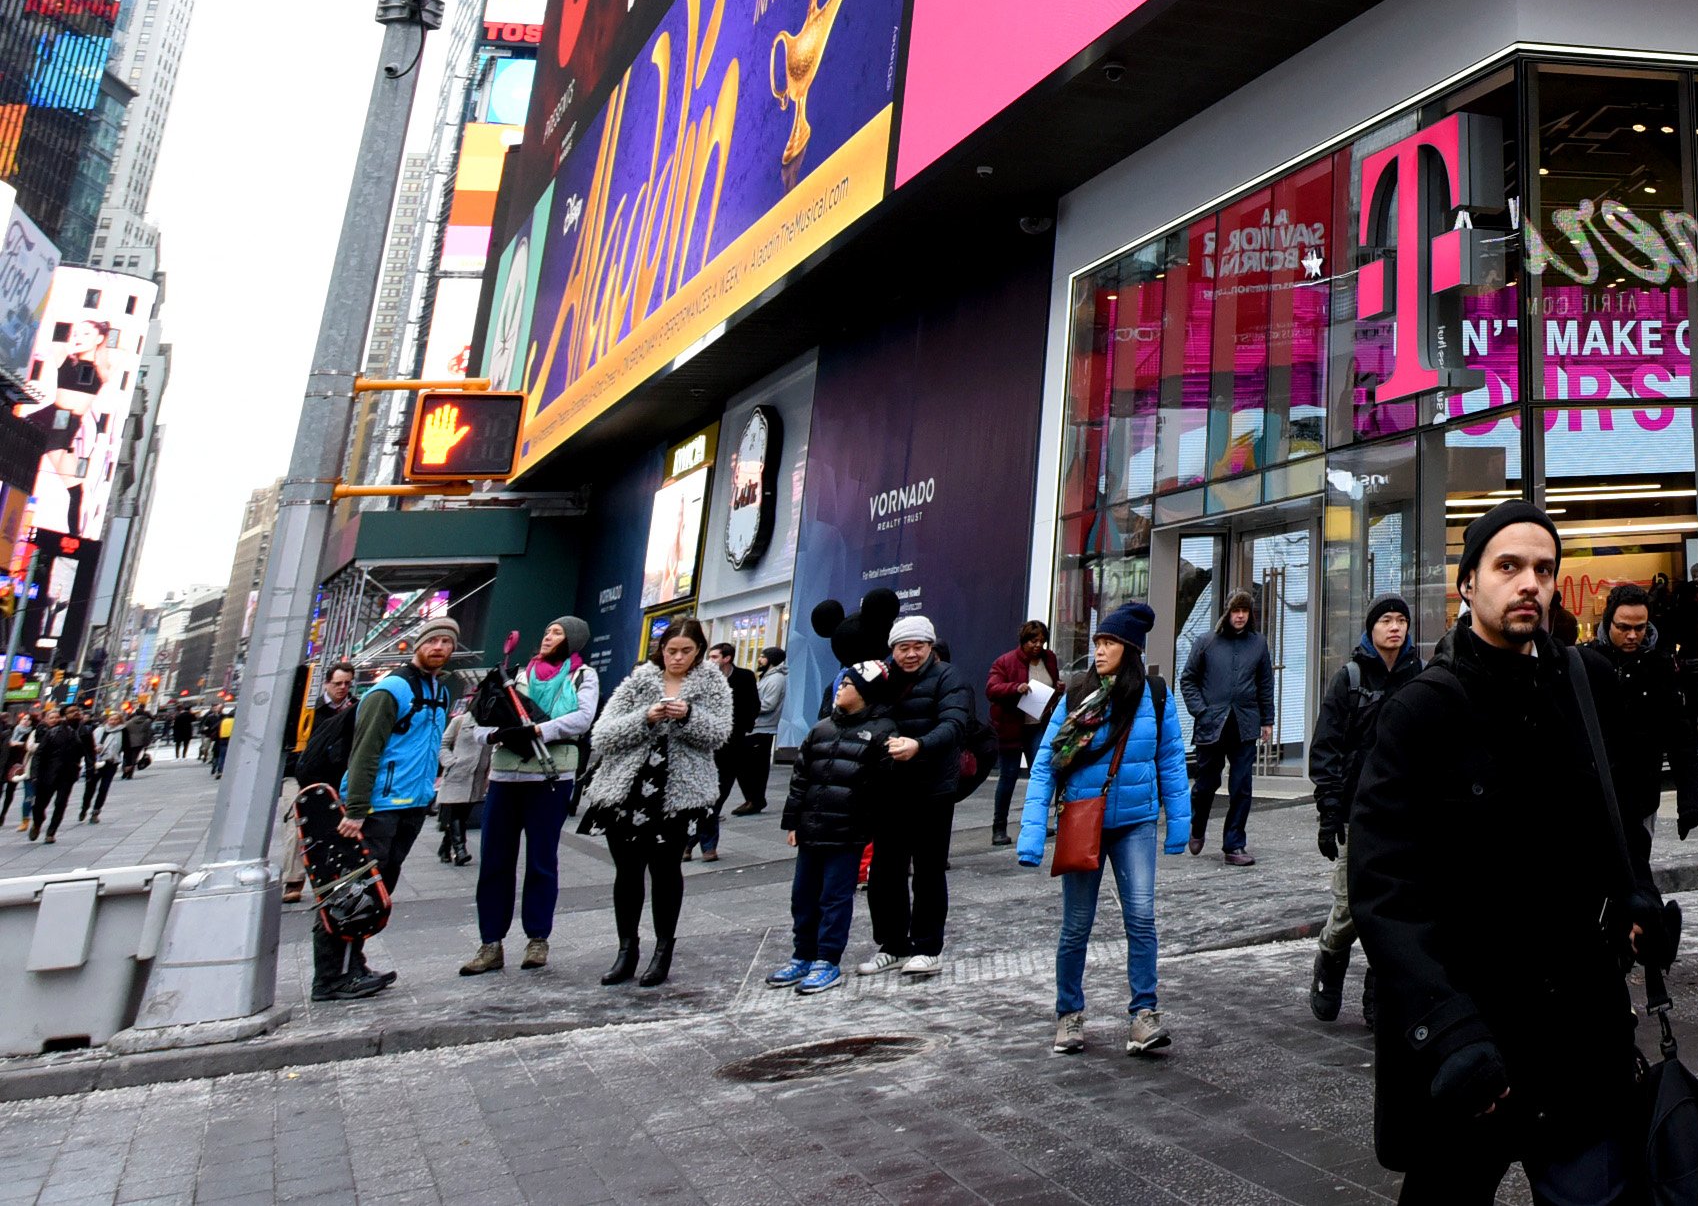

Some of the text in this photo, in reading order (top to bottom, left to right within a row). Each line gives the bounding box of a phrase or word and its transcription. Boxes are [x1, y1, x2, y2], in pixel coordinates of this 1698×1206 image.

[1358, 112, 1465, 403] T
[1546, 320, 1663, 356] MAKE
[870, 477, 935, 522] VORNADO
[877, 512, 923, 532] REALTY TRUST
